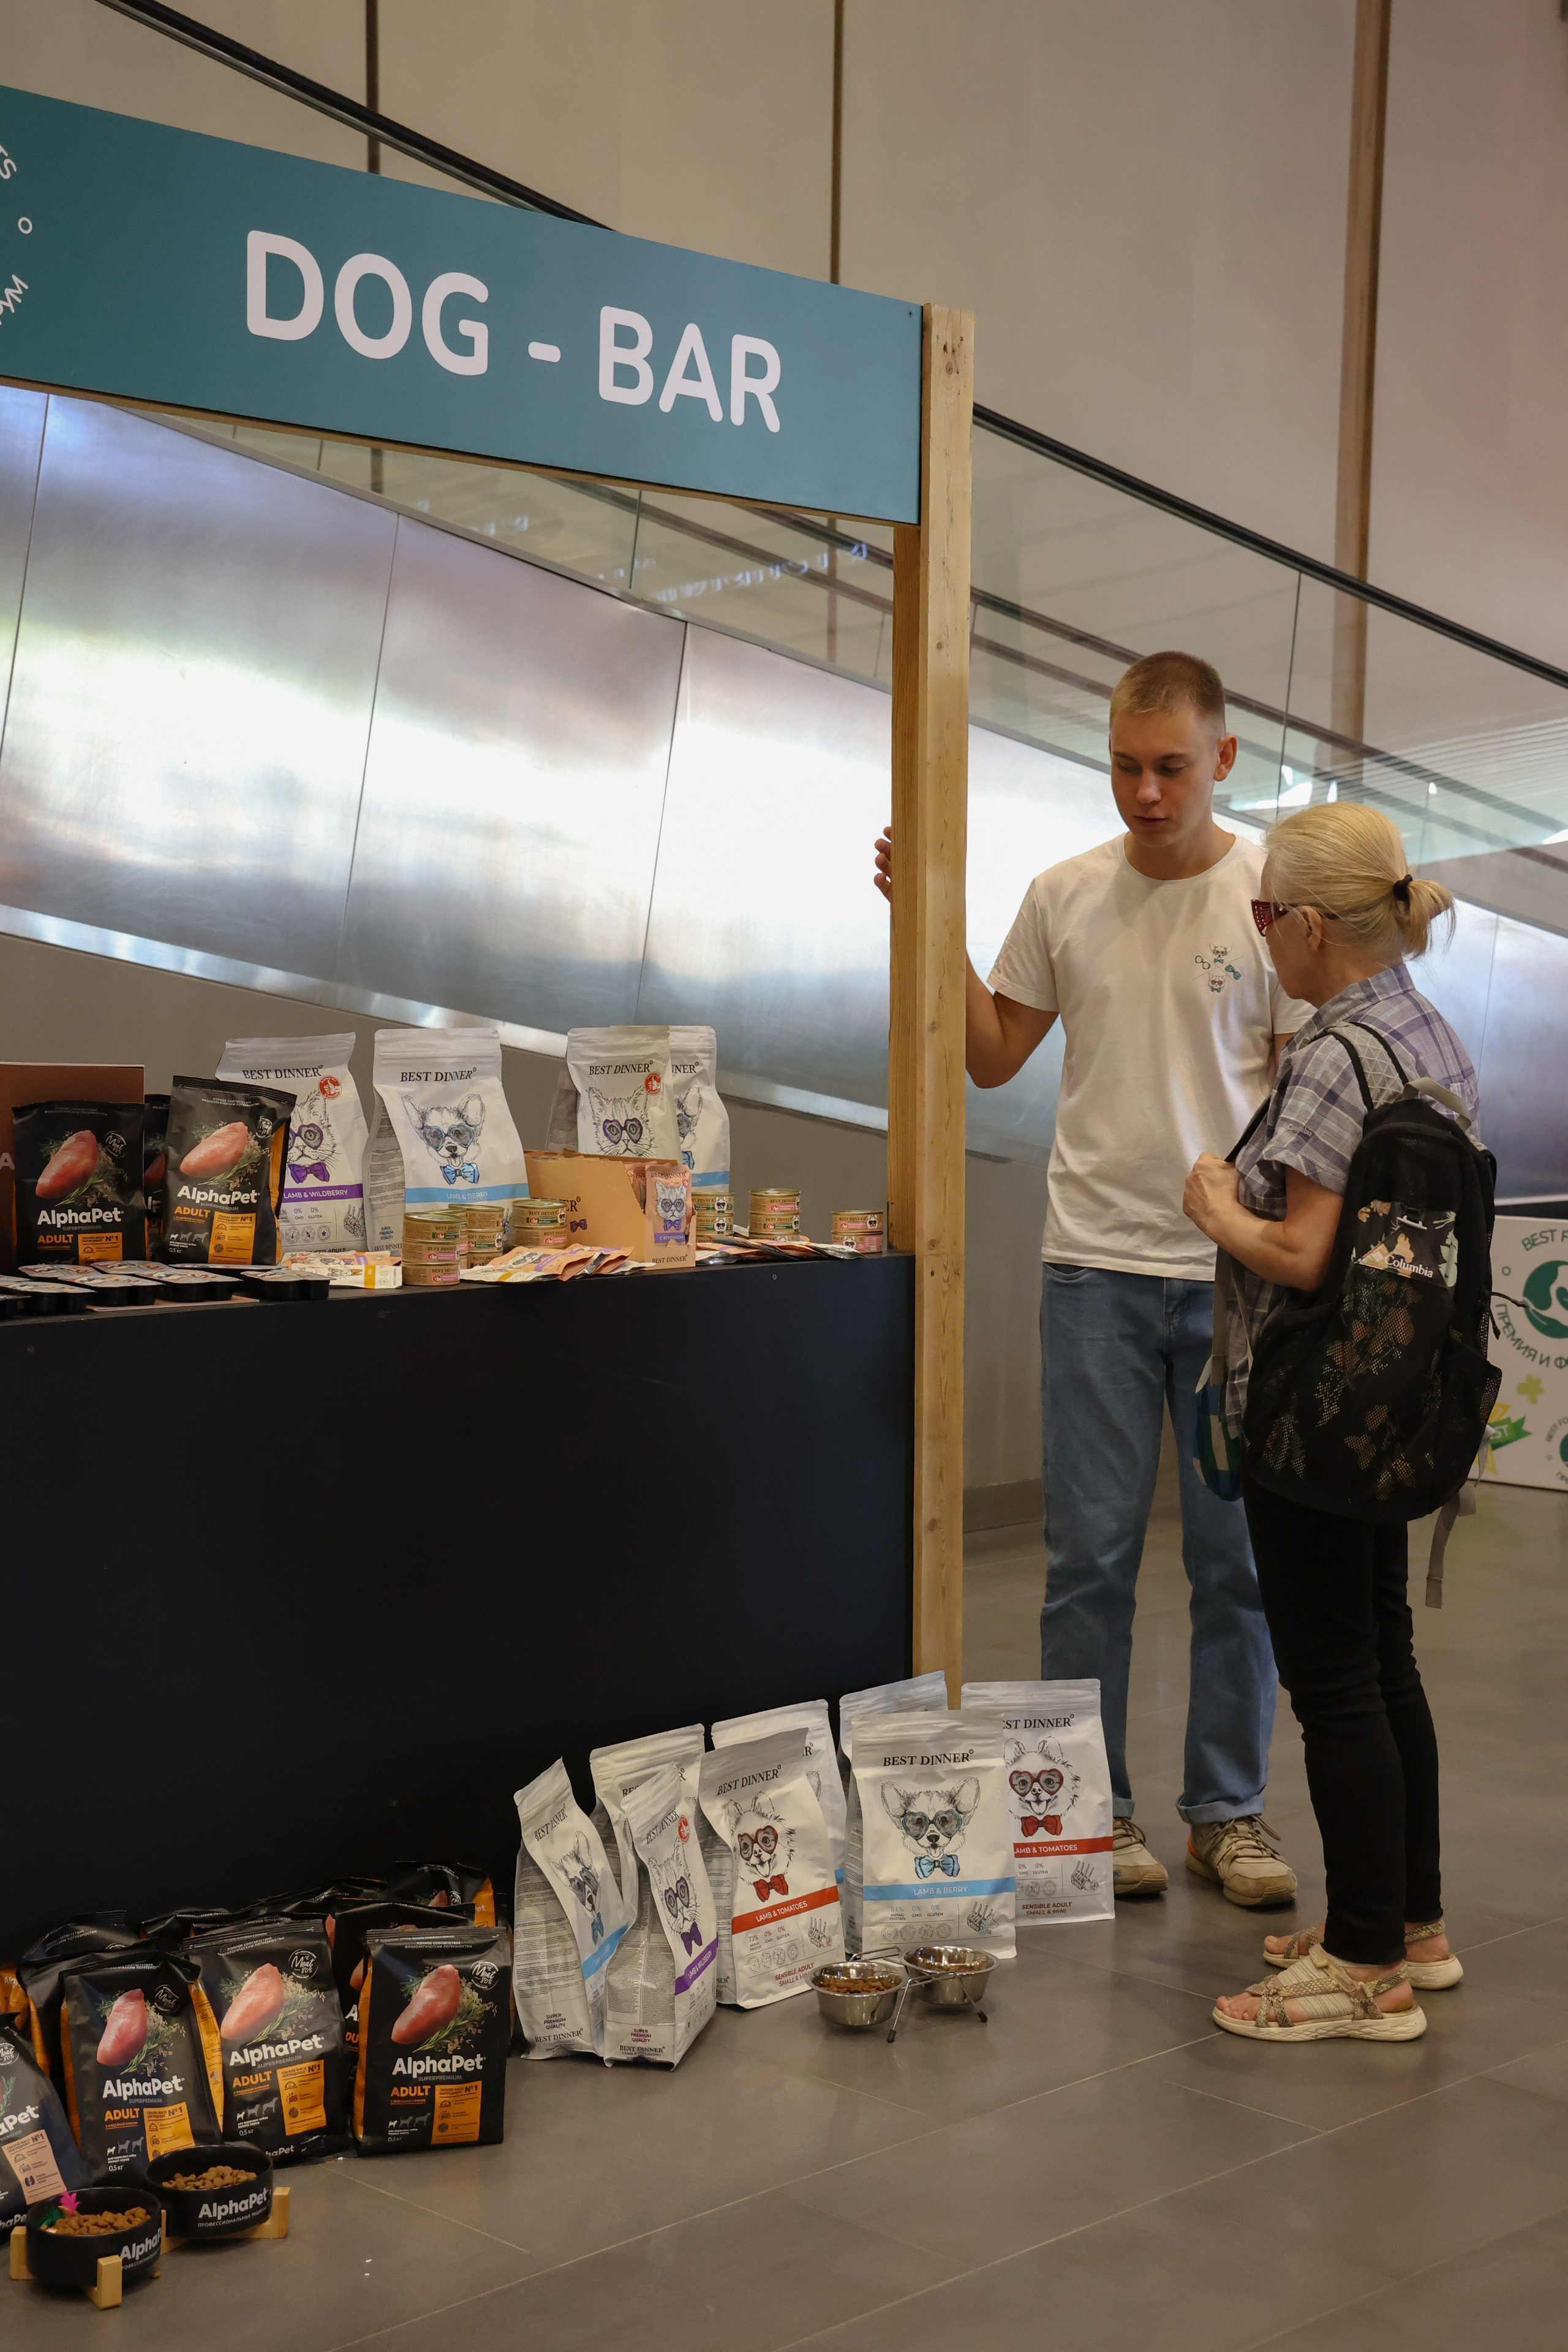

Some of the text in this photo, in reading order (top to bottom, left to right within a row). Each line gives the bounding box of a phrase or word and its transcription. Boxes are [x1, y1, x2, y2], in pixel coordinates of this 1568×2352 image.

[247, 230, 489, 376] DOG
[598, 305, 782, 433] BAR
[243, 1068, 322, 1080] BEST DINNER
[401, 1070, 473, 1082] BEST DINNER
[589, 1063, 650, 1076] BEST DINNER
[176, 1185, 257, 1205] AlphaPet
[174, 1206, 211, 1218] ADULT
[200, 1202, 239, 1211] SUPERPREMIUM
[37, 1207, 122, 1227] AlphaPet
[37, 1234, 74, 1243] ADULT
[1521, 1229, 1556, 1251] BEST
[1384, 1256, 1433, 1278] Columbia
[1495, 1303, 1551, 1368] ПРЕМИЯ И
[1490, 1425, 1509, 1441] ST
[1023, 1717, 1072, 1729] DINNER
[883, 1752, 970, 1766] BEST DINNER
[717, 1769, 778, 1796] BEST DINNER
[534, 1823, 550, 1842] BEST
[646, 1825, 658, 1845] BEST
[1038, 1844, 1077, 1853] TOMATOES
[914, 1887, 935, 1896] LAMB
[756, 1912, 772, 1923] LAMB
[778, 1901, 808, 1915] TOMATOES
[748, 1934, 759, 1943] 73%
[291, 1955, 315, 1969] Meat
[472, 1964, 497, 1979] Meat
[775, 1962, 815, 1981] SENSIBLE ADULT
[779, 1977, 795, 1987] SMALL
[155, 1990, 178, 2005] Meat
[553, 2030, 582, 2040] DINNER
[230, 2034, 323, 2067] AlphaPet
[257, 2055, 303, 2068] SUPERPREMIUM
[391, 2053, 483, 2078] AlphaPet
[232, 2070, 272, 2088] ADULT
[102, 2075, 183, 2100] AlphaPet
[390, 2086, 431, 2097] ADULT
[0, 2105, 40, 2135] aPet
[104, 2108, 140, 2121] ADULT
[198, 2187, 267, 2220] AlphaPet
[198, 2214, 251, 2227] ПРОФЕССИОНАЛЬНЫЕ
[120, 2227, 161, 2261] AlphaP
